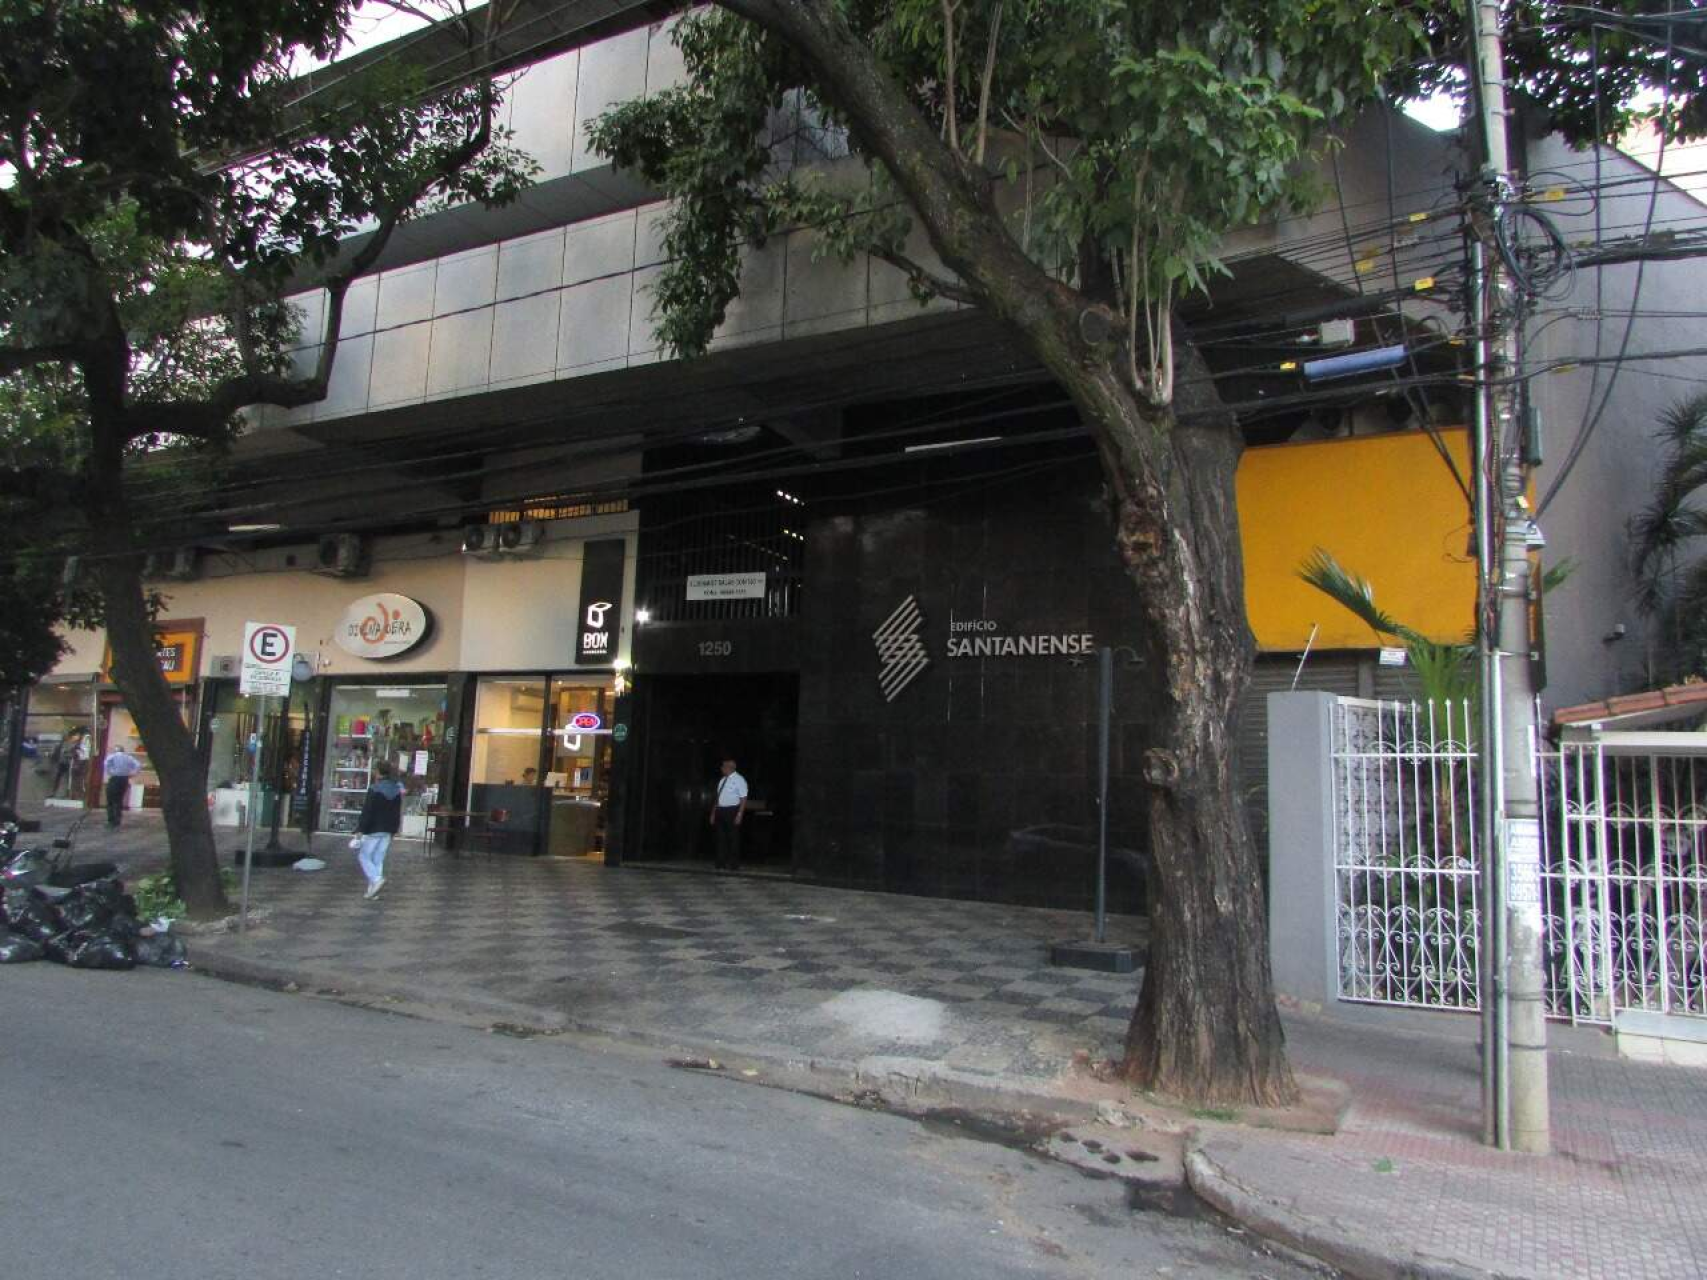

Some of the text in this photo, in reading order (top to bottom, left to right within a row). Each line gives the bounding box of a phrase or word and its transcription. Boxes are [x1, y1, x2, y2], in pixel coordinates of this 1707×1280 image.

[950, 620, 997, 631] EDIFÍCIO
[261, 632, 278, 656] E
[583, 632, 608, 649] BOX
[697, 641, 732, 656] 1250
[946, 634, 1094, 657] SANTANENSE
